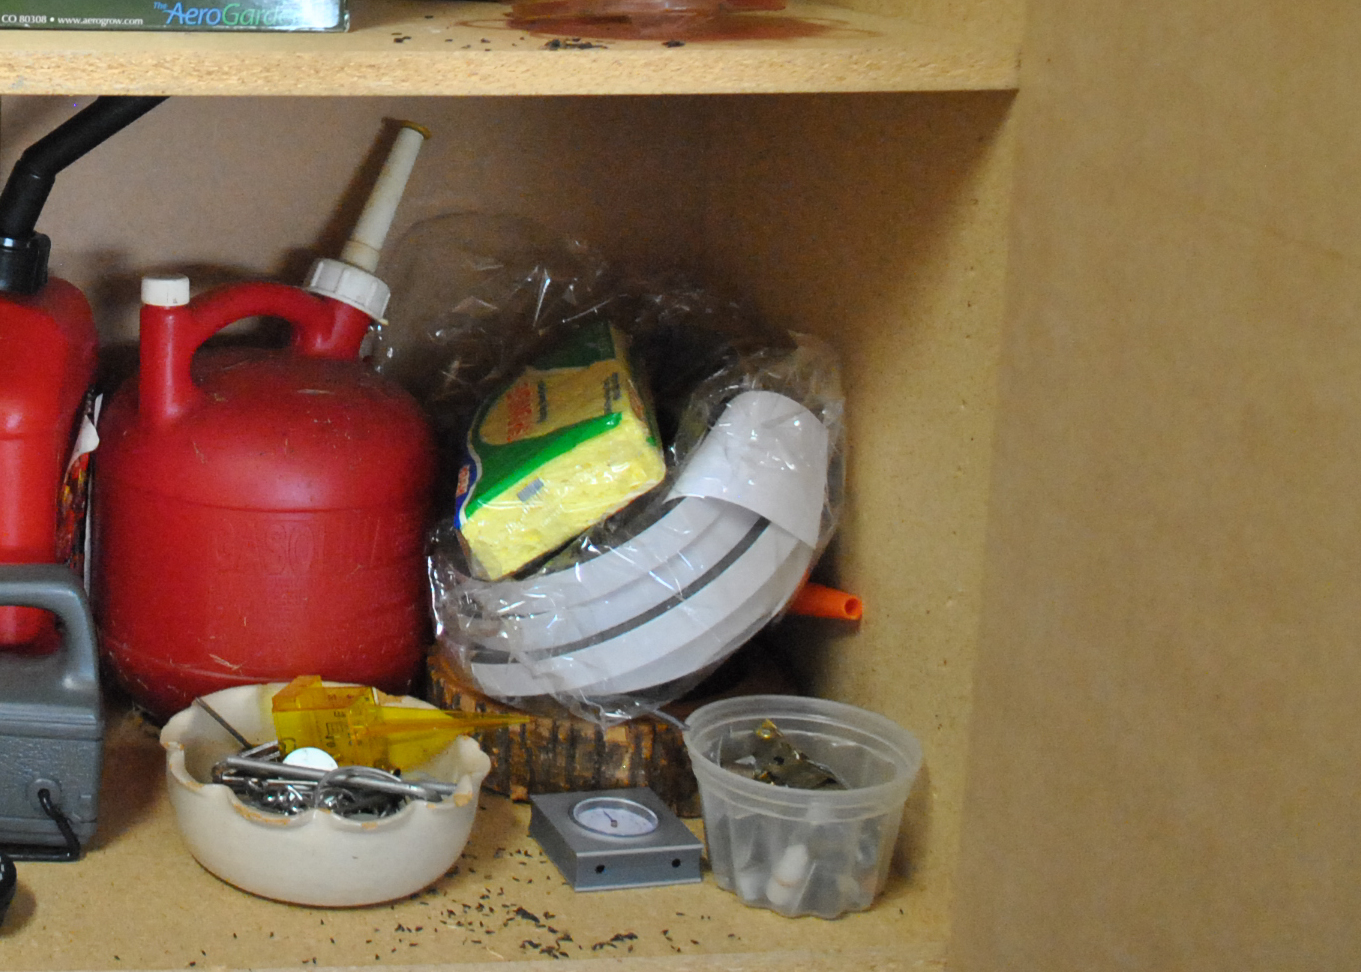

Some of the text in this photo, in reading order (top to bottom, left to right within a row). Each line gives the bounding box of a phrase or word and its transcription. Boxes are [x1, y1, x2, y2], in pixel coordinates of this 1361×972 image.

[153, 1, 169, 10] The
[1, 14, 17, 23] CO
[19, 14, 47, 24] 80308
[57, 16, 144, 27] www.aerogrow.com
